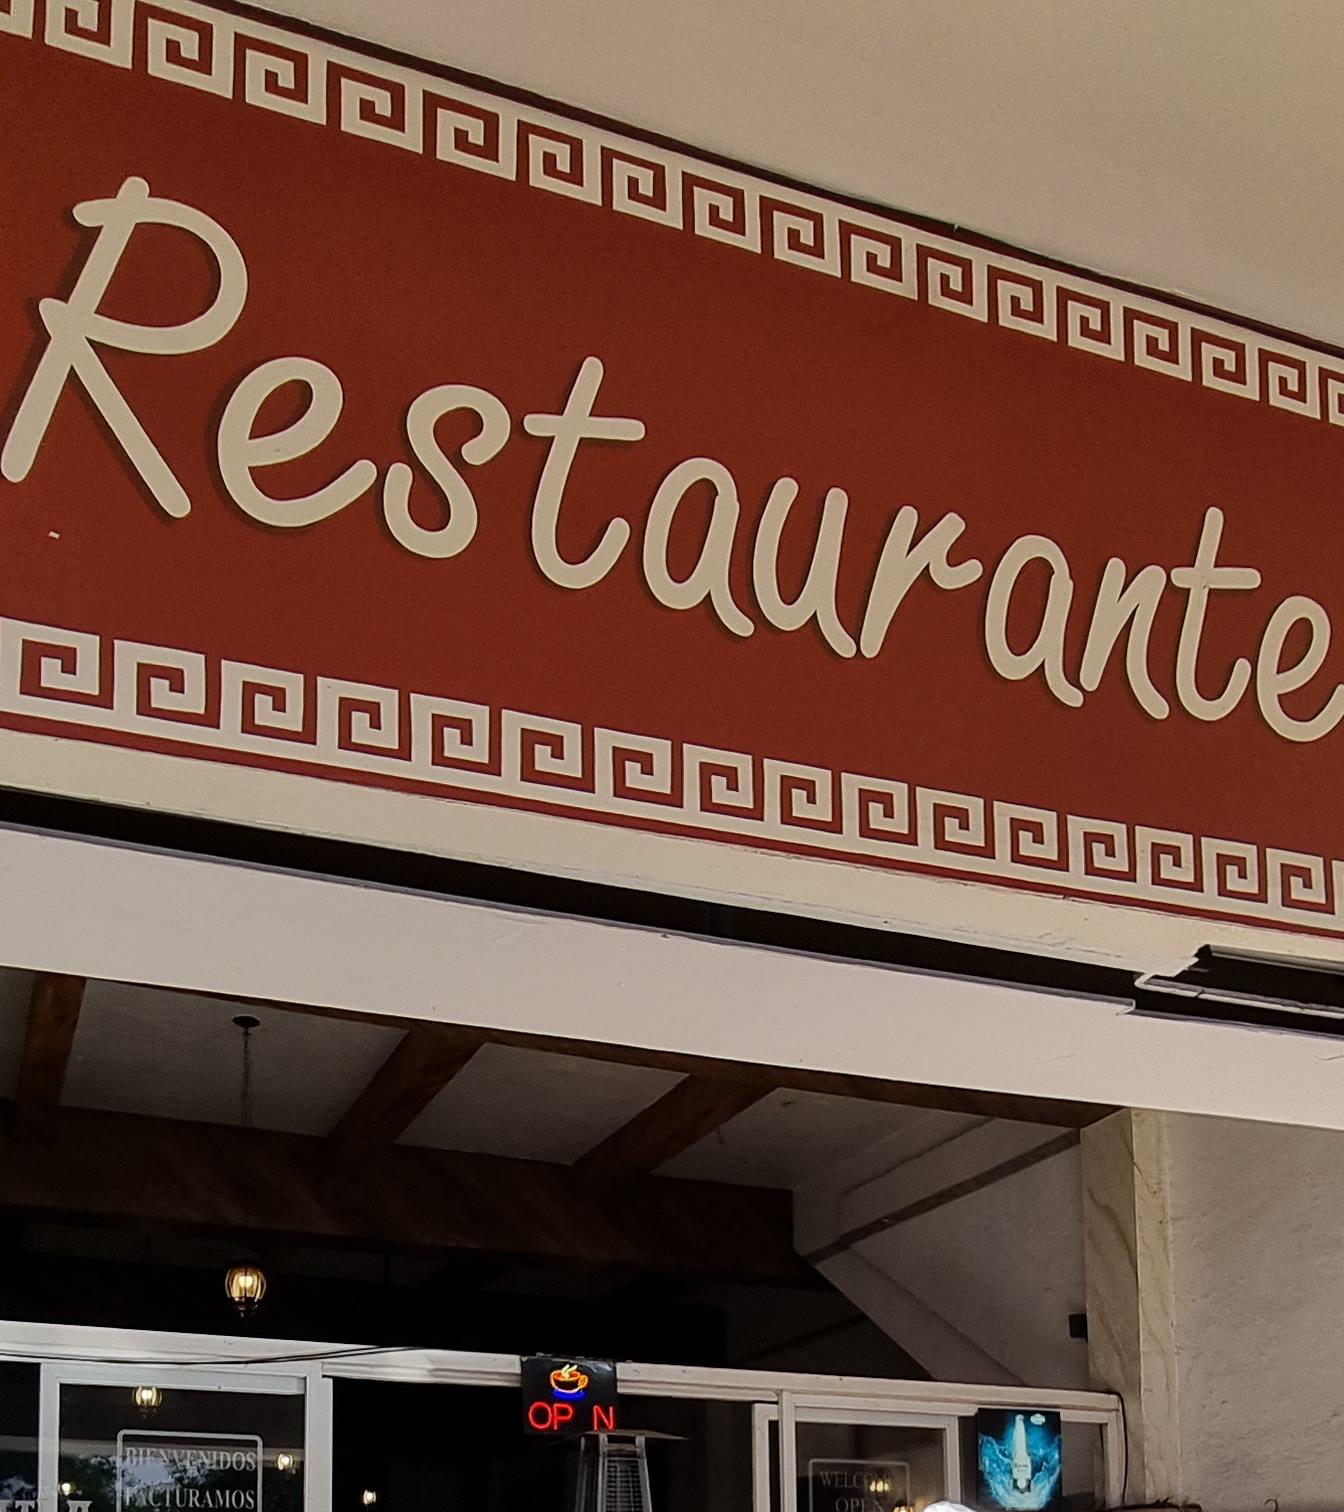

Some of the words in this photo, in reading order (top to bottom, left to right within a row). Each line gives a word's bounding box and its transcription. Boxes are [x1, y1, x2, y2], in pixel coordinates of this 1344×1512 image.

[528, 1401, 614, 1431] OPN
[819, 1471, 898, 1489] WELCO
[125, 1486, 255, 1510] FACTURAMOS
